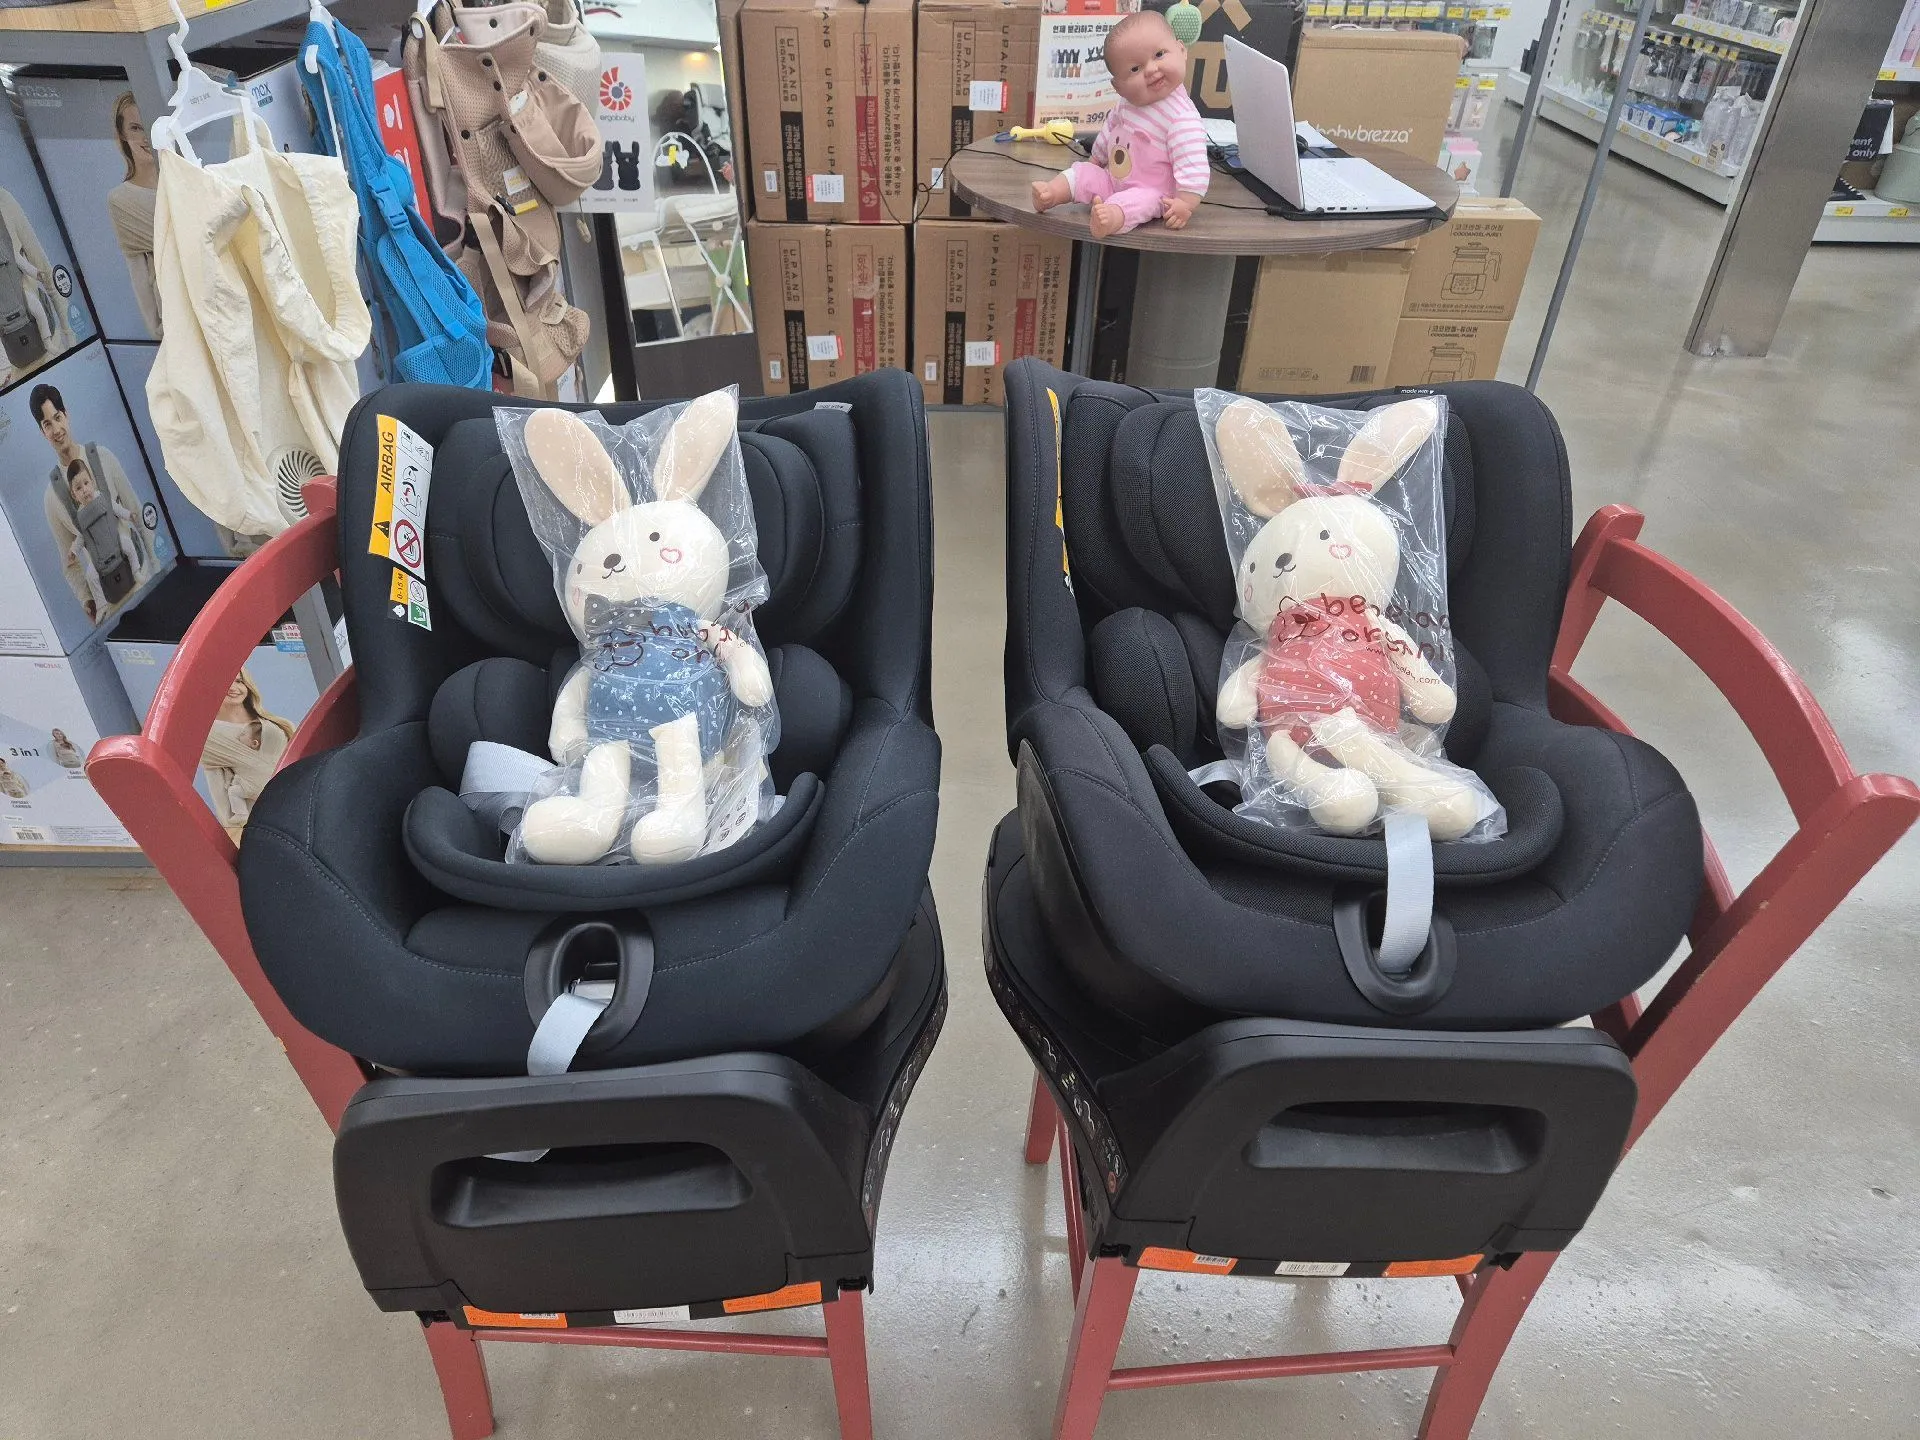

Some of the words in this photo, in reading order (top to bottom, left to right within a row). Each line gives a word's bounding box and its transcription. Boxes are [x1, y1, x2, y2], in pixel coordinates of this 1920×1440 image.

[787, 38, 798, 102] UPANG
[962, 32, 971, 96] UPANG
[1000, 25, 1009, 81] UPAN
[825, 67, 834, 128] UPANG
[859, 131, 867, 167] FRAGILE
[1853, 147, 1876, 159] only
[789, 249, 800, 302] UPANG
[956, 249, 964, 303] UPANG
[989, 233, 999, 287] UPANG
[826, 265, 835, 315] UPANG
[828, 331, 837, 378] UNG
[380, 431, 394, 494] AIRBAG
[396, 582, 404, 600] 0-15
[397, 572, 404, 580] M
[10, 747, 18, 757] 3
[20, 747, 32, 757] in
[33, 748, 40, 757] 1
